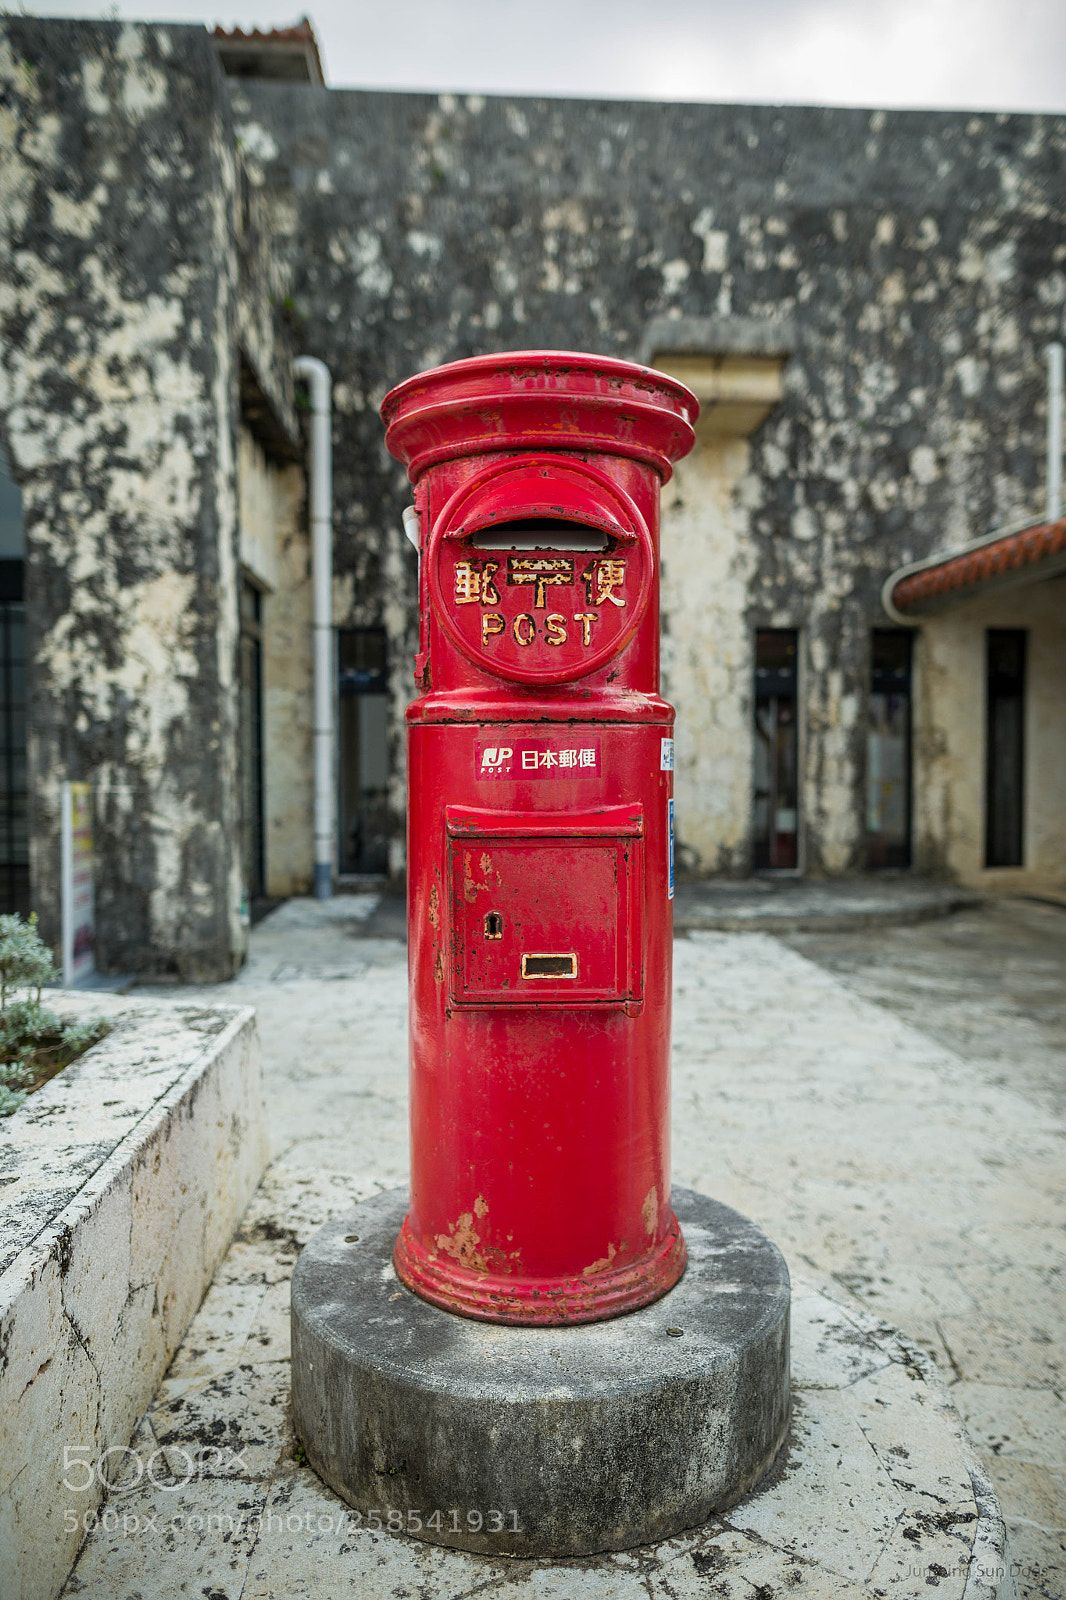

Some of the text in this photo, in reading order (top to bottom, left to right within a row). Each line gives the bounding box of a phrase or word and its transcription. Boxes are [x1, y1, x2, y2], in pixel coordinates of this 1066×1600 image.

[482, 613, 598, 646] POST
[481, 748, 513, 766] JP
[521, 749, 597, 769] 日本郵便
